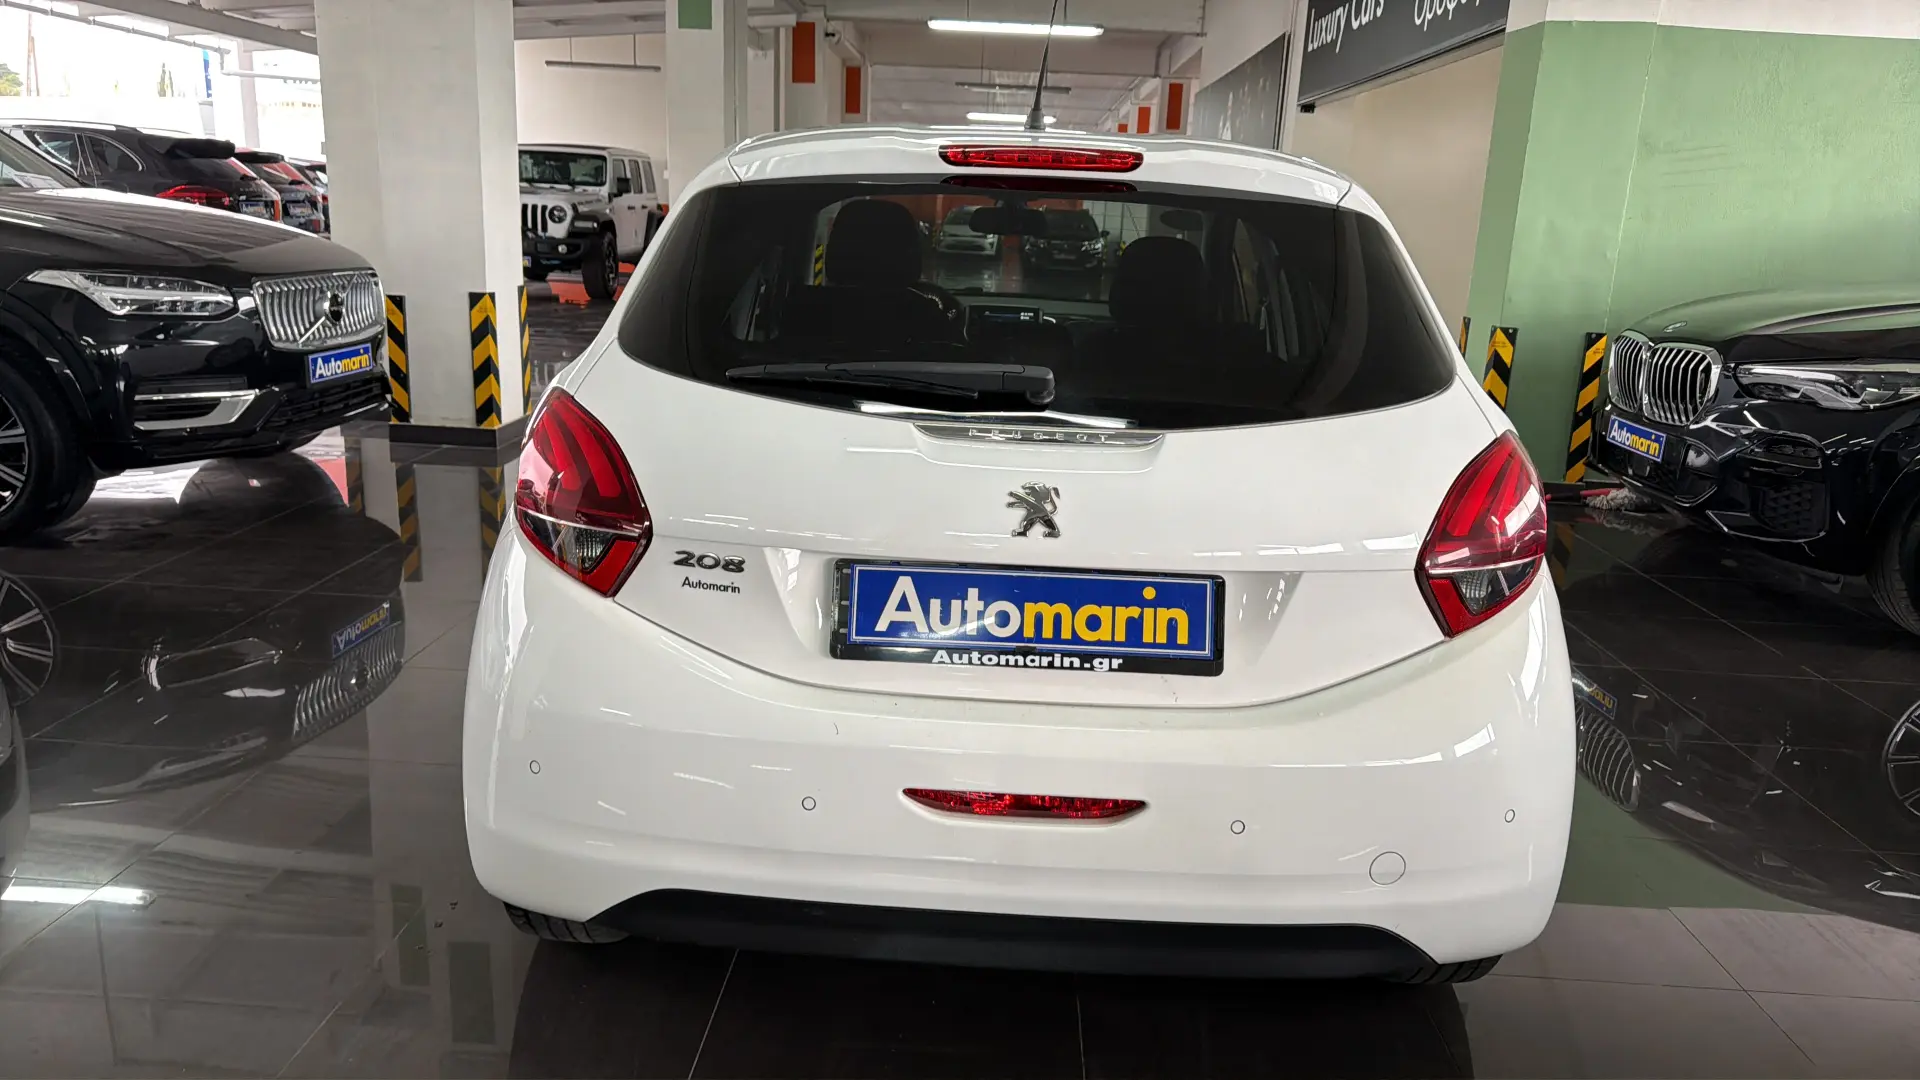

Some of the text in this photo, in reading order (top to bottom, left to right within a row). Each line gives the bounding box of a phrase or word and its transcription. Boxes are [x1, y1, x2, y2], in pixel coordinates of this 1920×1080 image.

[1307, 2, 1349, 54] Luxury
[315, 348, 370, 379] Automarin
[1609, 420, 1660, 457] Automarin
[673, 549, 746, 573] 208
[681, 576, 741, 594] Automarin
[874, 575, 1189, 645] Automarin
[931, 649, 1123, 672] Automarin.gr
